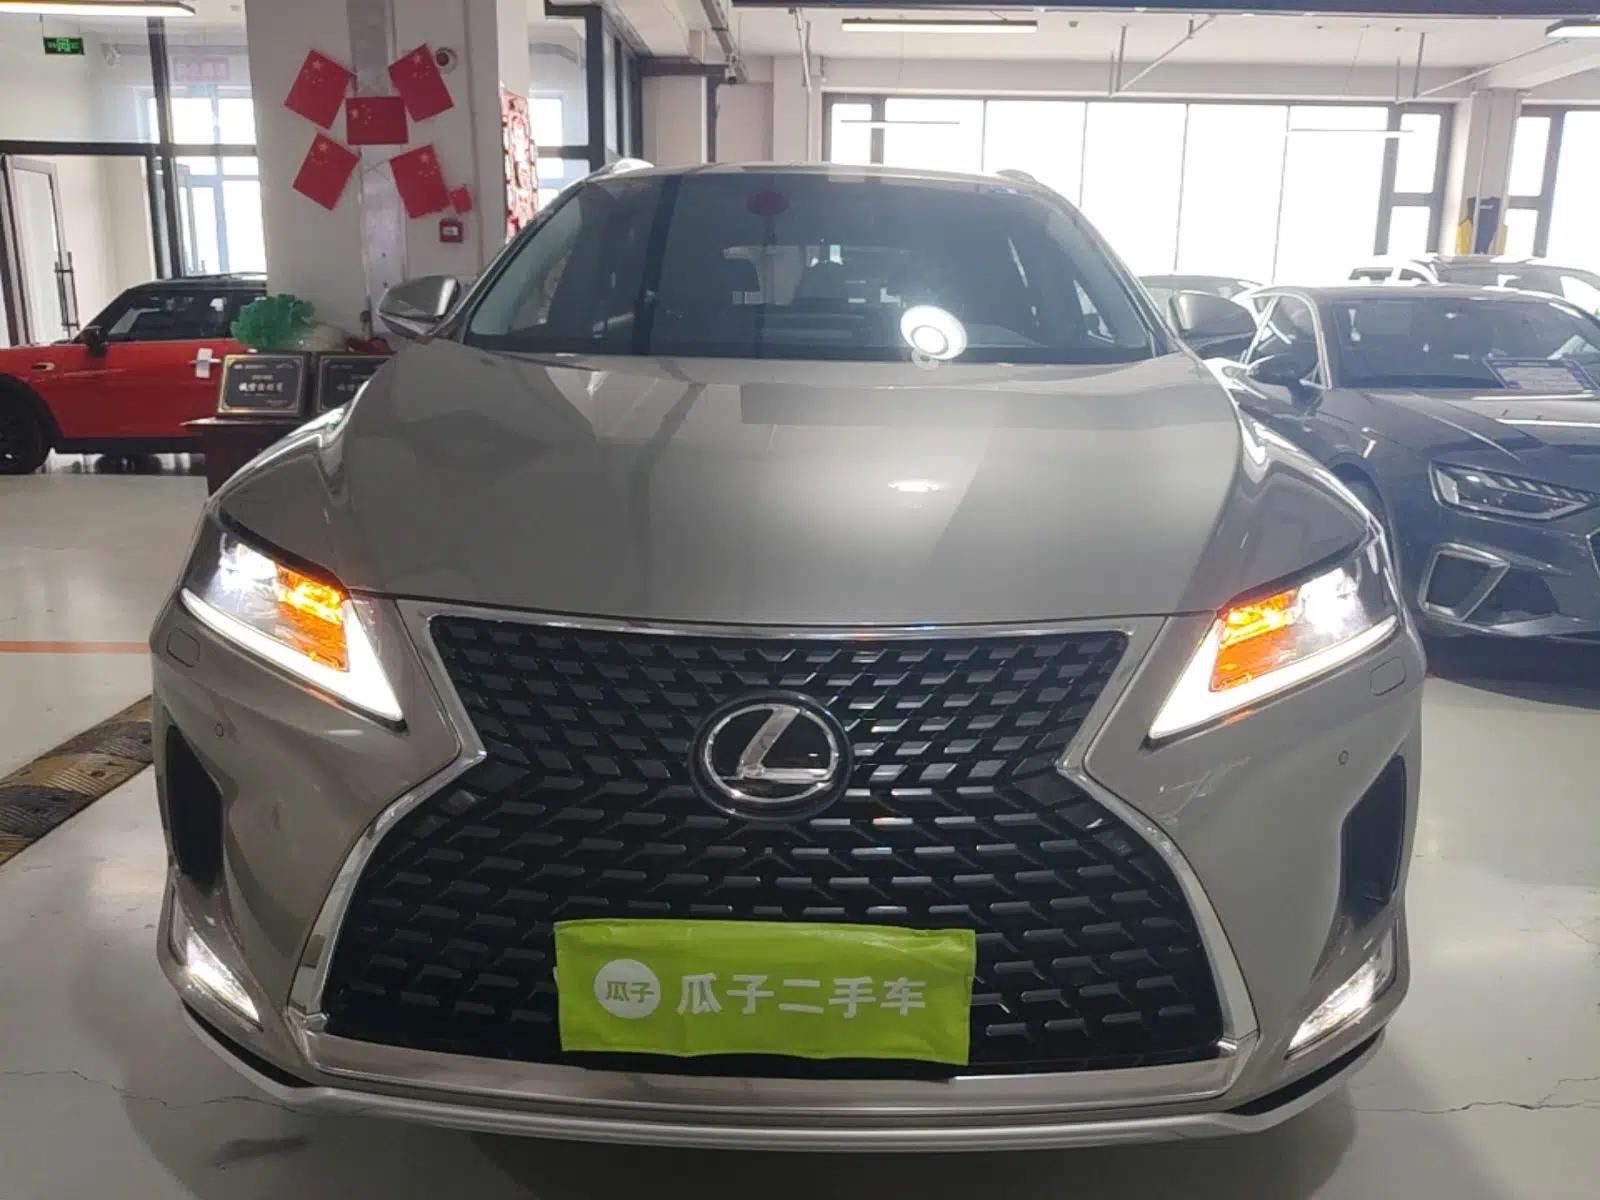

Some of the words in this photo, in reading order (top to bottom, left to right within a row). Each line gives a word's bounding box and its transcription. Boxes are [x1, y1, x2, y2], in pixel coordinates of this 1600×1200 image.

[605, 980, 656, 1004] 瓜子
[676, 972, 927, 1019] 瓜子二手车
